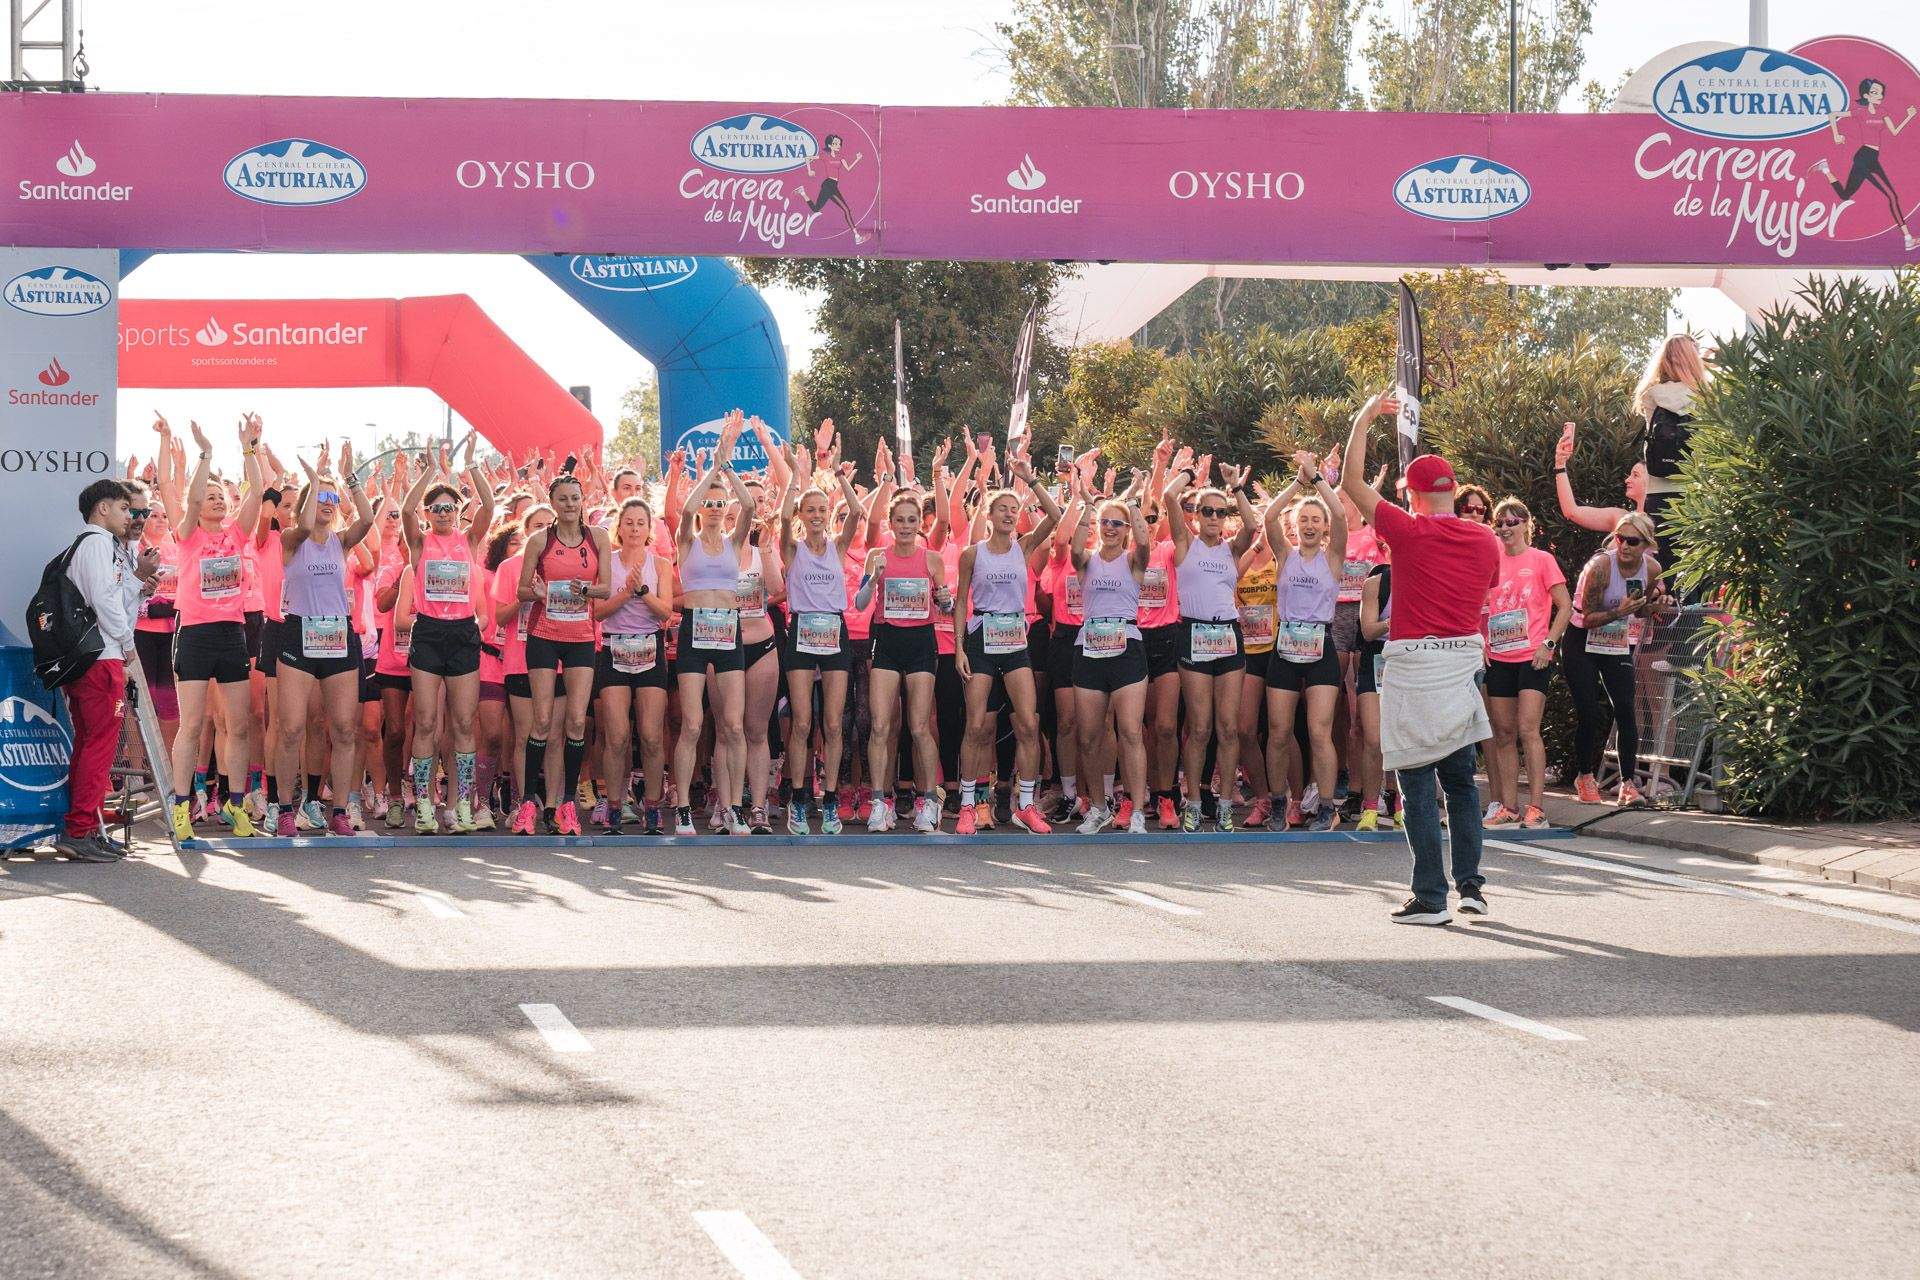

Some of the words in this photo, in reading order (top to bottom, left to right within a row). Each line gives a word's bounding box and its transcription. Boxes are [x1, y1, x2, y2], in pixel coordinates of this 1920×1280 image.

[1698, 78, 1760, 88] CENTRAL
[1766, 79, 1827, 89] LECHERA
[1668, 79, 1832, 115] ASTURIANA
[701, 135, 807, 159] ASTURIANA
[1634, 132, 1797, 182] Carrera
[235, 162, 356, 189] ASTURIANA
[256, 161, 301, 169] CENTRAL
[306, 162, 352, 170] LECHERA
[456, 160, 596, 190] OYSHO
[19, 180, 133, 201] Santander
[679, 168, 784, 201] Carrera
[1169, 170, 1306, 200] OYSHO
[1404, 178, 1520, 204] ASTURIANA
[970, 194, 1082, 214] Santander
[704, 201, 724, 223] de
[728, 201, 742, 223] la
[739, 198, 823, 249] Mujer
[1673, 183, 1704, 217] de
[1710, 183, 1732, 217] la
[1725, 177, 1856, 258] Mujer
[581, 257, 690, 279] ASTURIANA
[11, 283, 104, 304] ASTURIANA
[232, 322, 368, 346] Santander
[191, 356, 278, 367] sportssantander.es
[8, 389, 99, 406] Santander
[0, 450, 109, 474] OYSHO
[308, 563, 338, 571] OYSHO
[986, 572, 1017, 580] OYSHO
[1198, 560, 1229, 571] OYSHO
[805, 573, 835, 581] OYSHO
[1091, 578, 1122, 588] OYSHO
[1289, 575, 1319, 585] OYSHO
